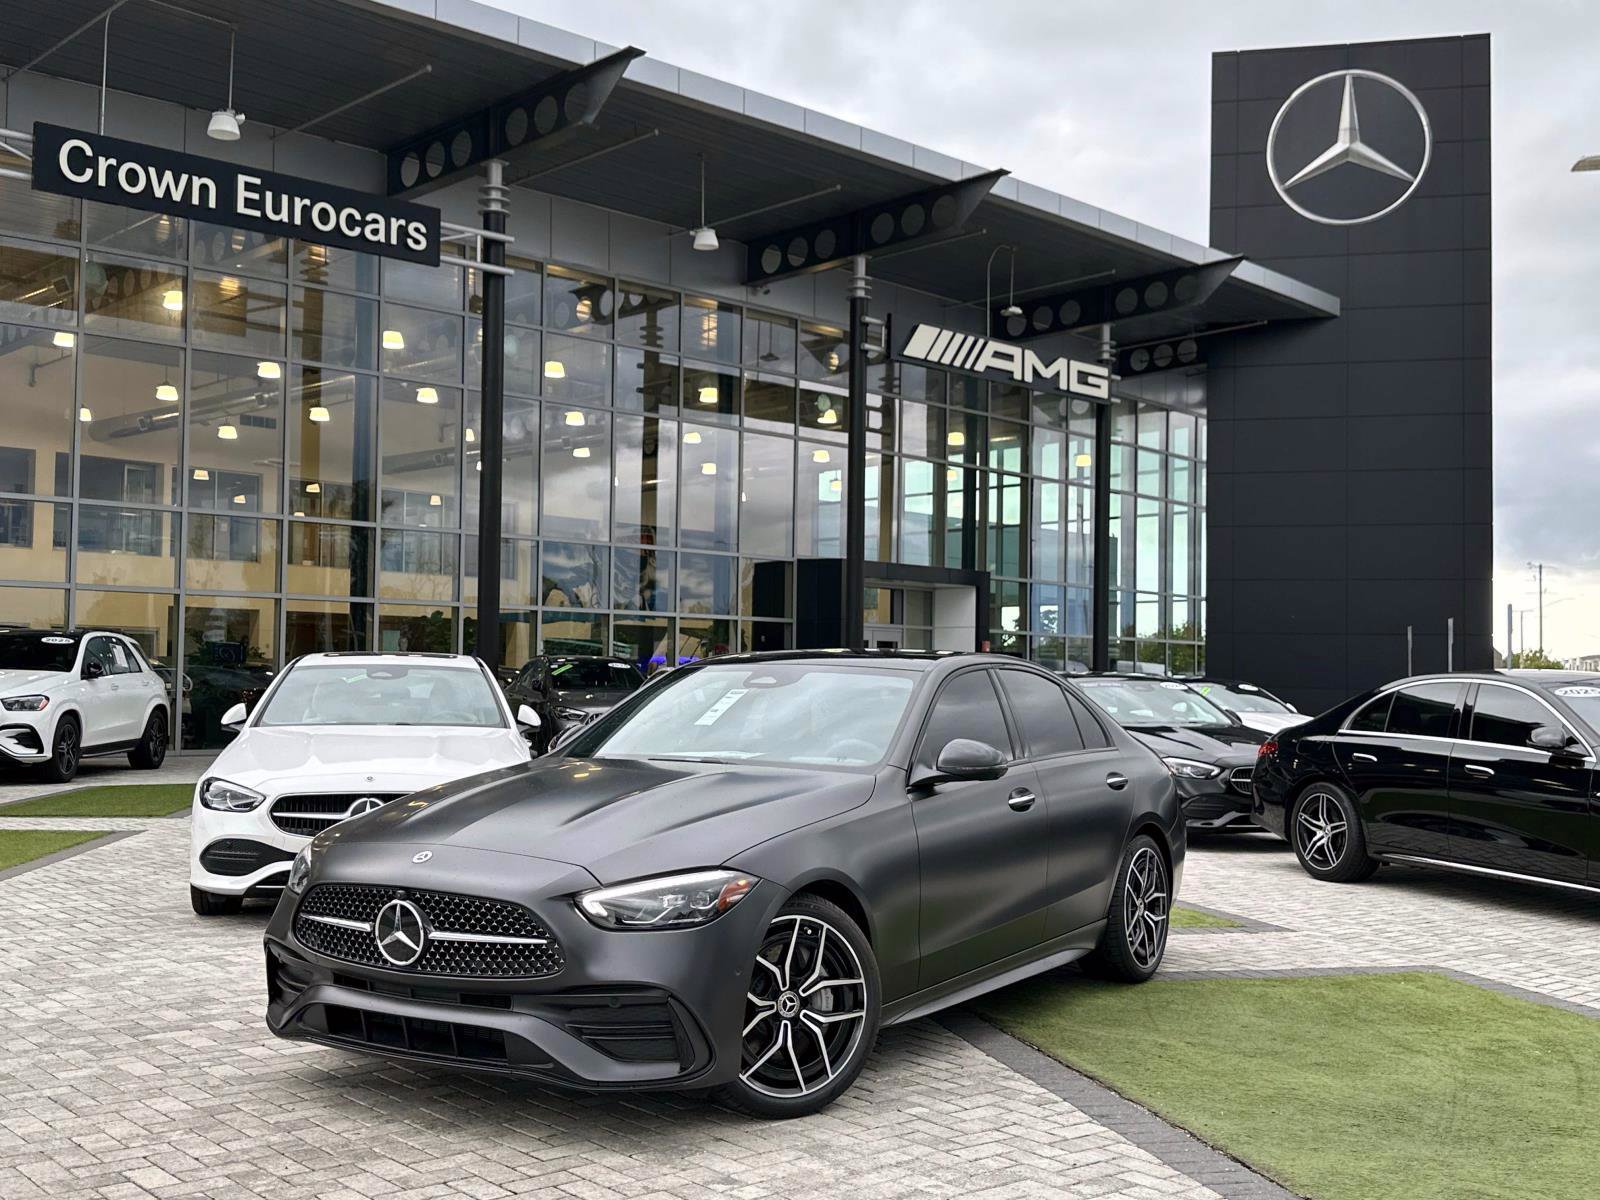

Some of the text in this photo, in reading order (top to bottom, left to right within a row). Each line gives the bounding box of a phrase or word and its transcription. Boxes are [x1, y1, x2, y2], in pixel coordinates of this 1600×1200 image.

[58, 138, 428, 252] Crown Eurocars
[973, 339, 1109, 400] AMG
